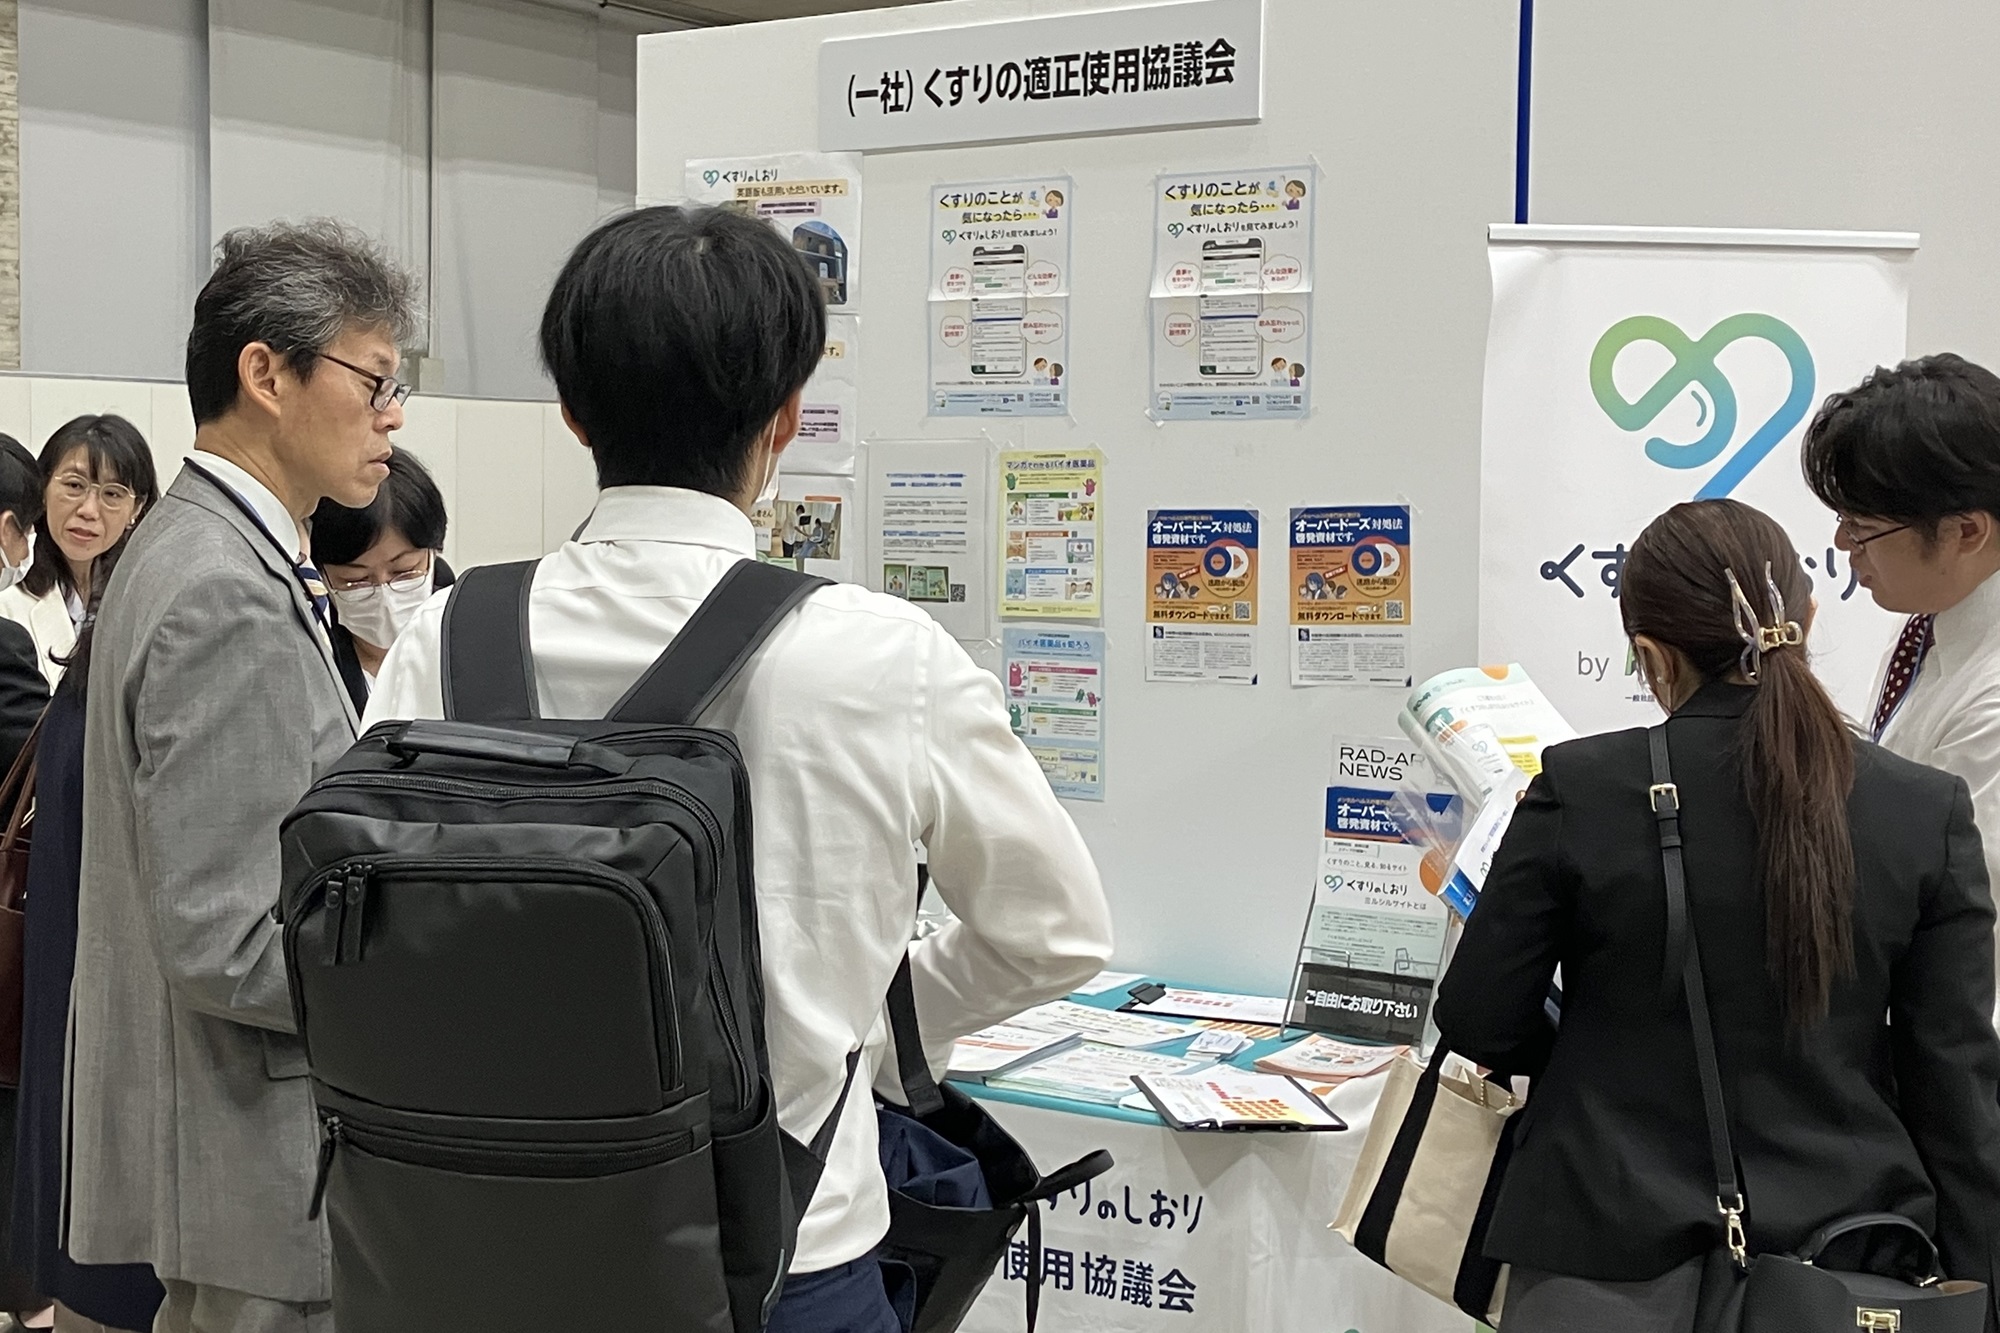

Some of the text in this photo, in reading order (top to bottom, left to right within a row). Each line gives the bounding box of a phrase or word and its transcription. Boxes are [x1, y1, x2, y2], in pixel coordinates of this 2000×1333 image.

[722, 169, 778, 183] くすりのしおり
[940, 190, 1023, 208] くすりのことが
[1165, 180, 1260, 200] くすりのことが
[1152, 533, 1208, 545] 啓発資材です。
[1295, 532, 1355, 544] 啓発資材です。
[1577, 651, 1610, 682] by
[1339, 762, 1403, 781] NEWS
[1347, 880, 1408, 896] くすりのしおり
[1364, 897, 1427, 910] ミルシルサイトとは
[1304, 989, 1418, 1020] ご自由にお取り下さい
[1048, 1180, 1203, 1234] りのしおり
